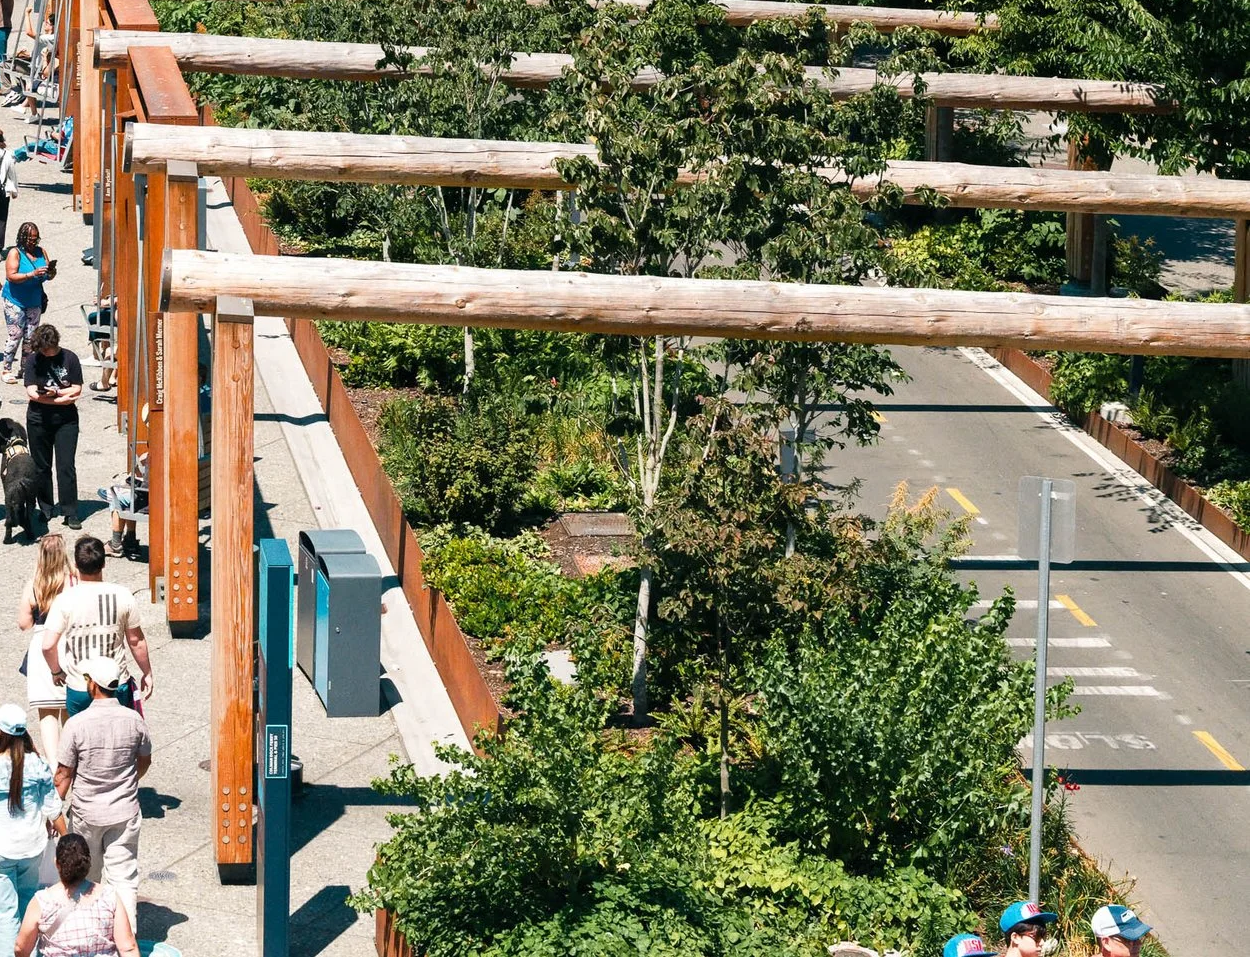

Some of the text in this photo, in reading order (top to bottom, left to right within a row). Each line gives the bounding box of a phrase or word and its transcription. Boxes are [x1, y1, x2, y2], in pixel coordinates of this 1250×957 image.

[155, 339, 163, 356] Sarah
[155, 361, 163, 389] McKibben
[155, 389, 164, 405] Craig
